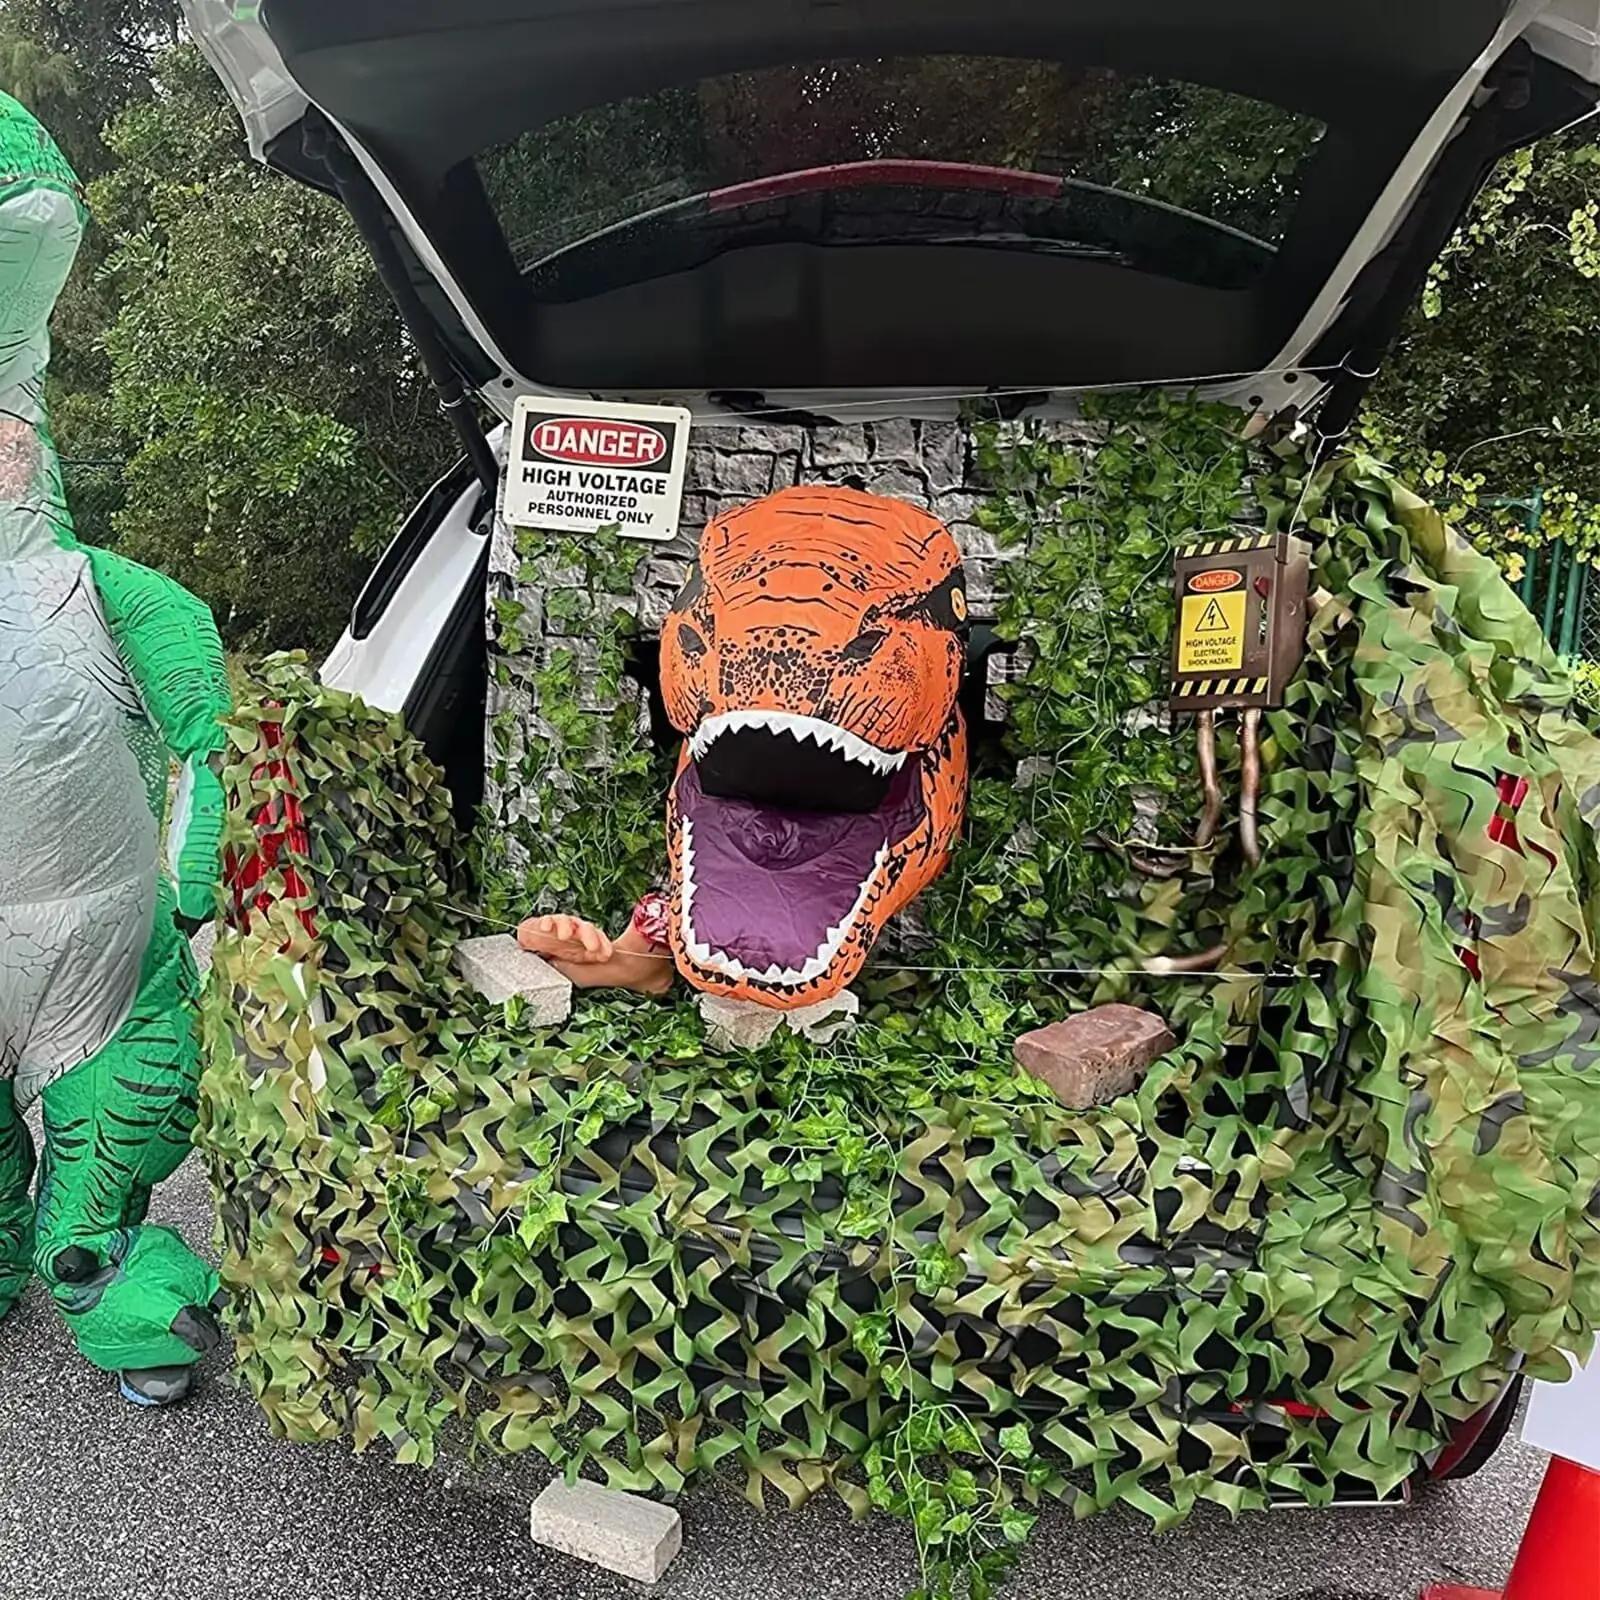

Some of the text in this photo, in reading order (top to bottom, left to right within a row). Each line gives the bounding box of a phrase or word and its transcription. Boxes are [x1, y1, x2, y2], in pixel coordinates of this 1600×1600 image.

[540, 425, 657, 459] DANGER
[522, 467, 667, 495] HIGH VOLTAGE
[546, 490, 637, 508] AUTHORIZED
[528, 502, 654, 525] PERSONNEL ONLY
[1195, 574, 1235, 588] DANGER
[1185, 636, 1237, 648] HIGH VOLTAGE
[1193, 648, 1228, 657] ELECTRICAL
[1209, 657, 1233, 665] HAZARD
